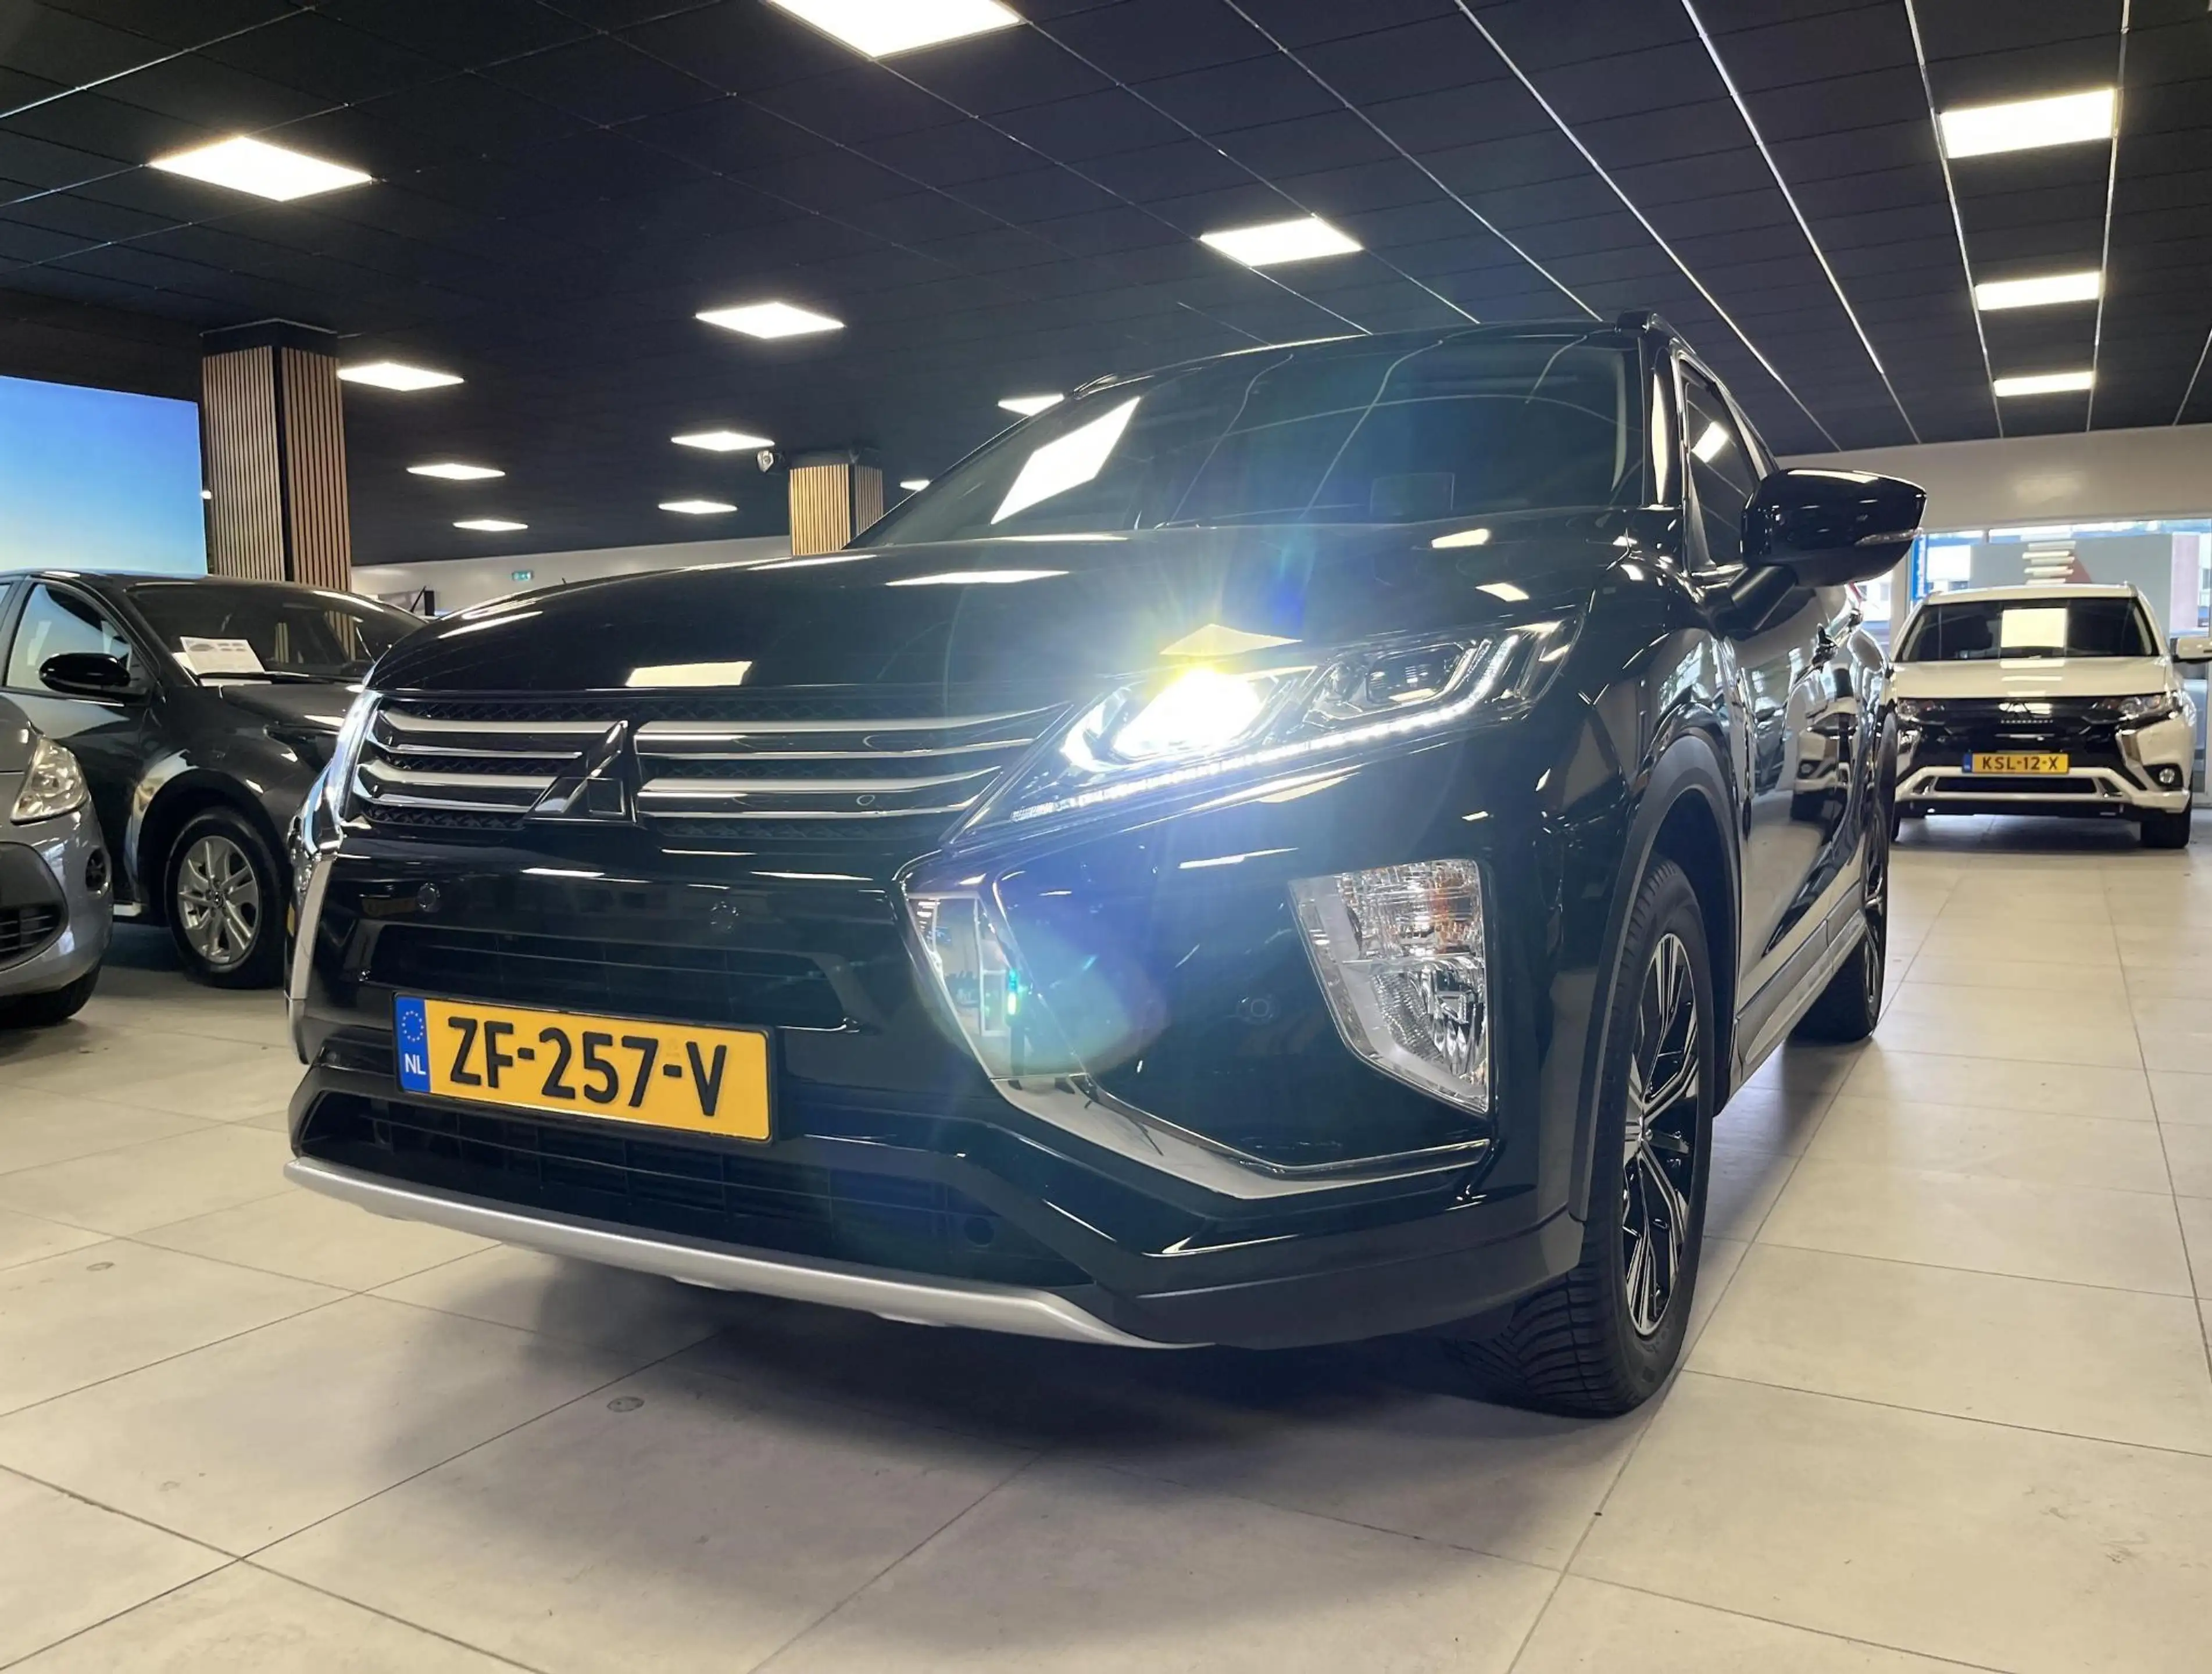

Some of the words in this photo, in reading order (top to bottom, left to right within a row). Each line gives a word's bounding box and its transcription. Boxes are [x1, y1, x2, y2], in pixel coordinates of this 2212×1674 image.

[1982, 756, 2059, 770] KSL-12-X
[405, 1053, 427, 1075] NL
[448, 1016, 727, 1117] ZF-257-V
